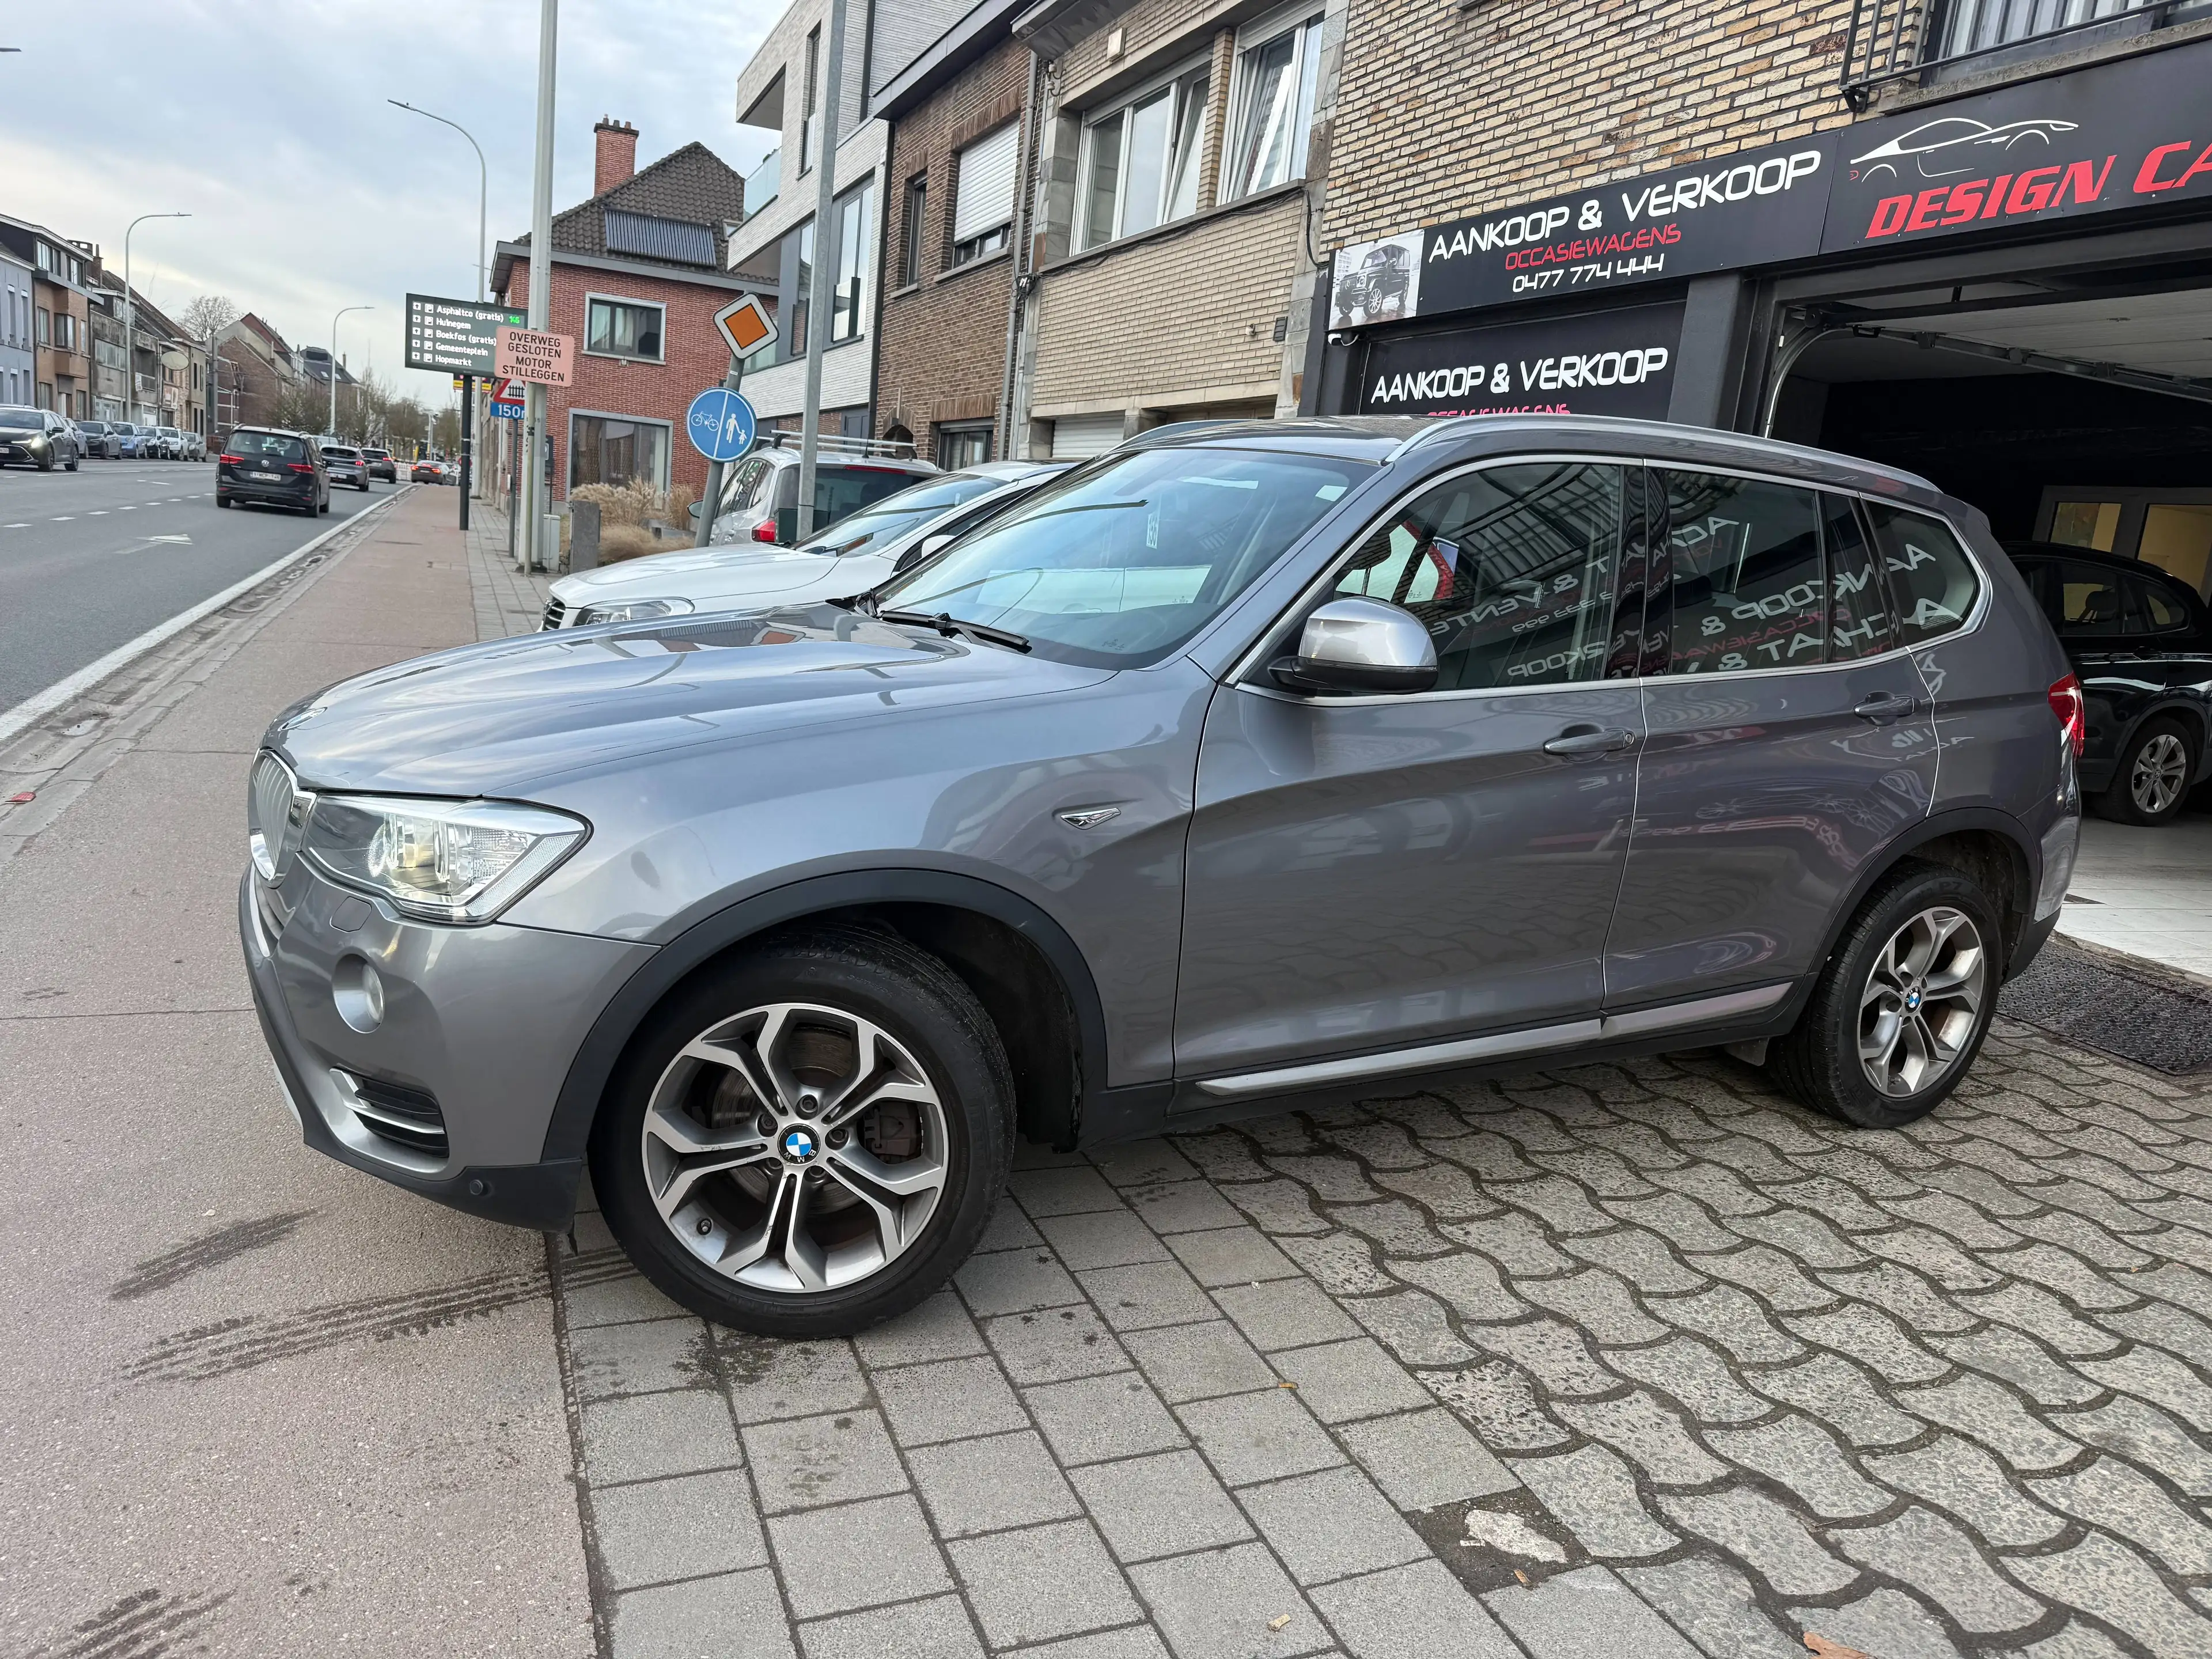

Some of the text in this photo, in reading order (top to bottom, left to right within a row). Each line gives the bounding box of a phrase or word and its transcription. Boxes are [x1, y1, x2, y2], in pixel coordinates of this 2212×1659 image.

[1866, 141, 2212, 239] DESIGN CA
[1429, 150, 1821, 263] AANKOOP & VERKOOP
[1505, 223, 1681, 270] OCCASIEWAGENS
[1512, 253, 1665, 293] 0477 774 444
[436, 305, 474, 317] Asphaltco
[475, 310, 504, 323] (gratis)
[436, 317, 471, 329] Huinegem
[435, 329, 467, 341] Boekfos
[509, 331, 561, 348] OVERWEG
[435, 342, 488, 356] Gemeenteplein
[507, 342, 562, 358] GESLOTEN
[435, 354, 472, 366] Hopmarkt
[516, 355, 552, 369] MOTOR
[502, 365, 565, 382] STILLEGGEN
[1370, 347, 1668, 404] AANKOOP & VERKOOP
[784, 1149, 817, 1162] BMW
